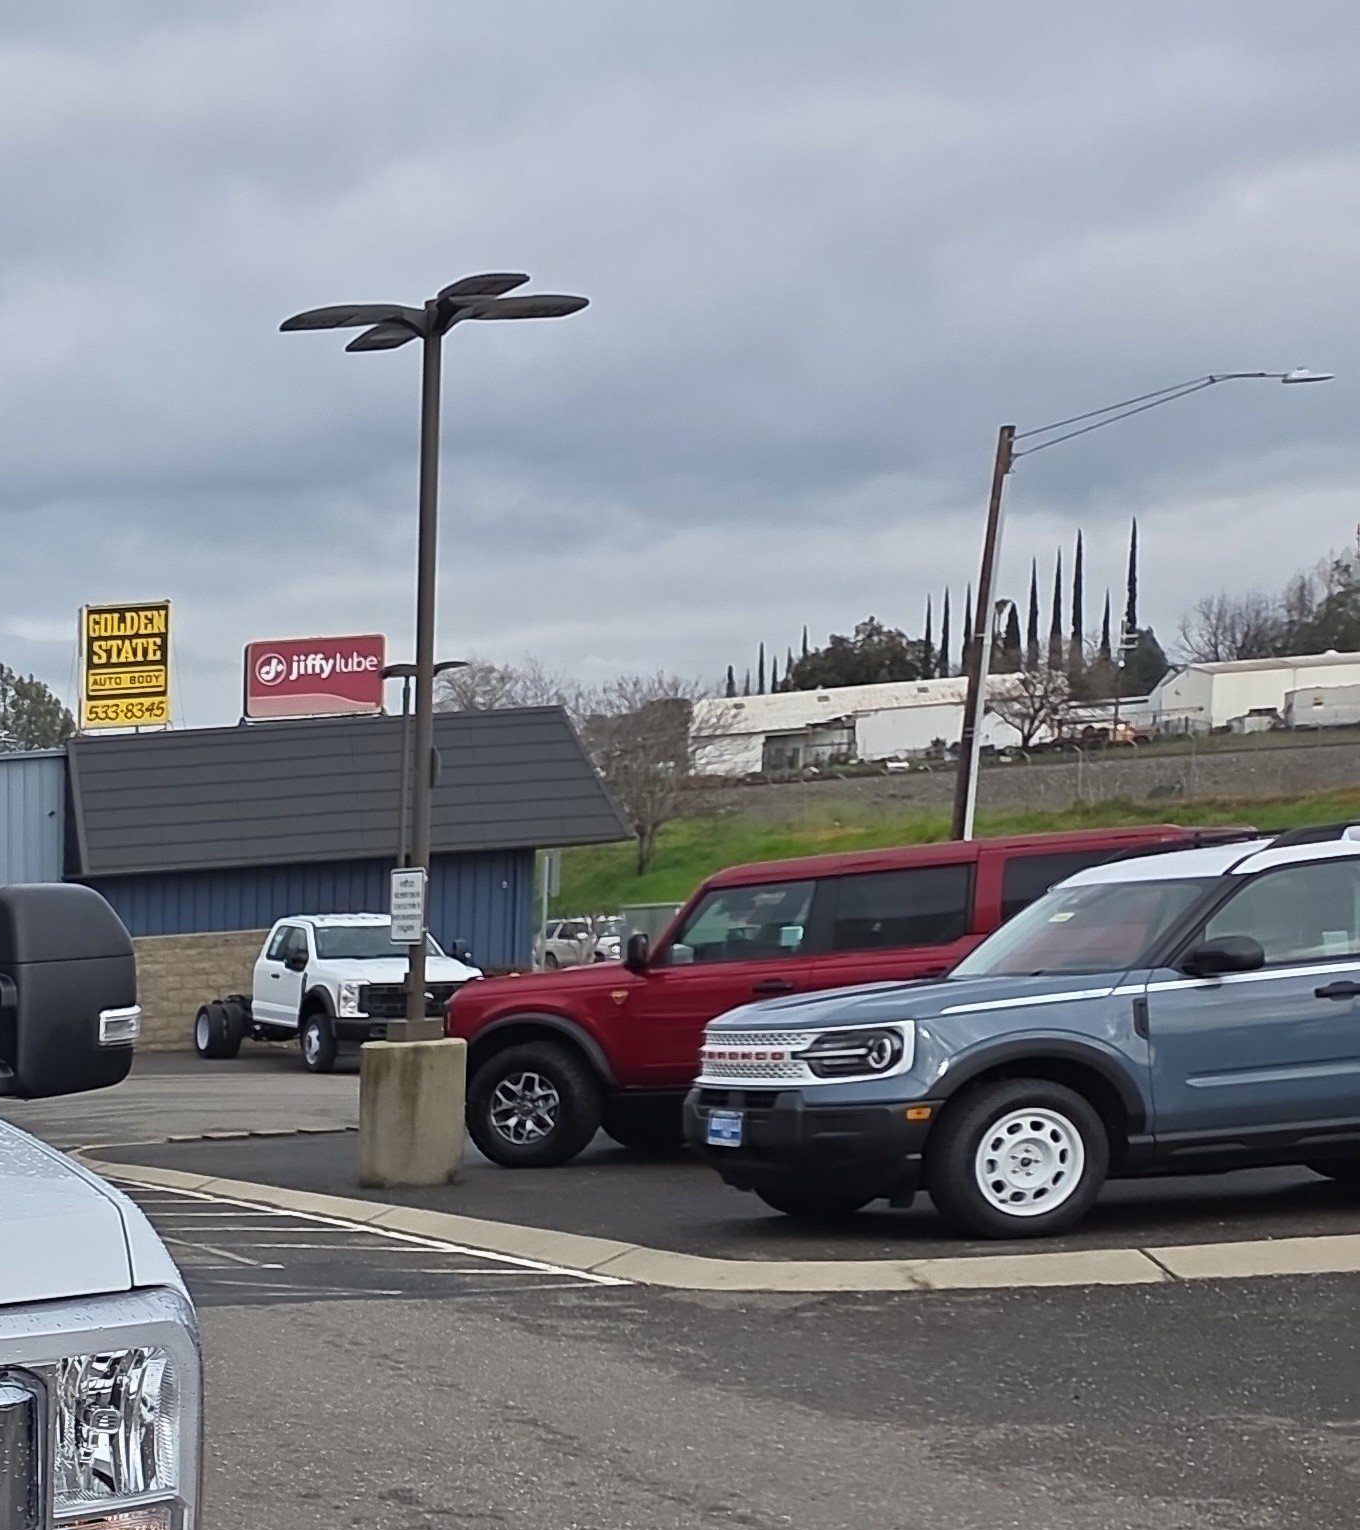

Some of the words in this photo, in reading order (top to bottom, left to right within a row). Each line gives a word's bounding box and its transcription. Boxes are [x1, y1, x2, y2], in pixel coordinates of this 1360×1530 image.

[88, 609, 167, 638] GOLDEN
[91, 637, 162, 664] STATE
[91, 676, 123, 687] AUTO
[128, 674, 161, 685] BODY
[86, 701, 166, 722] 533-8345
